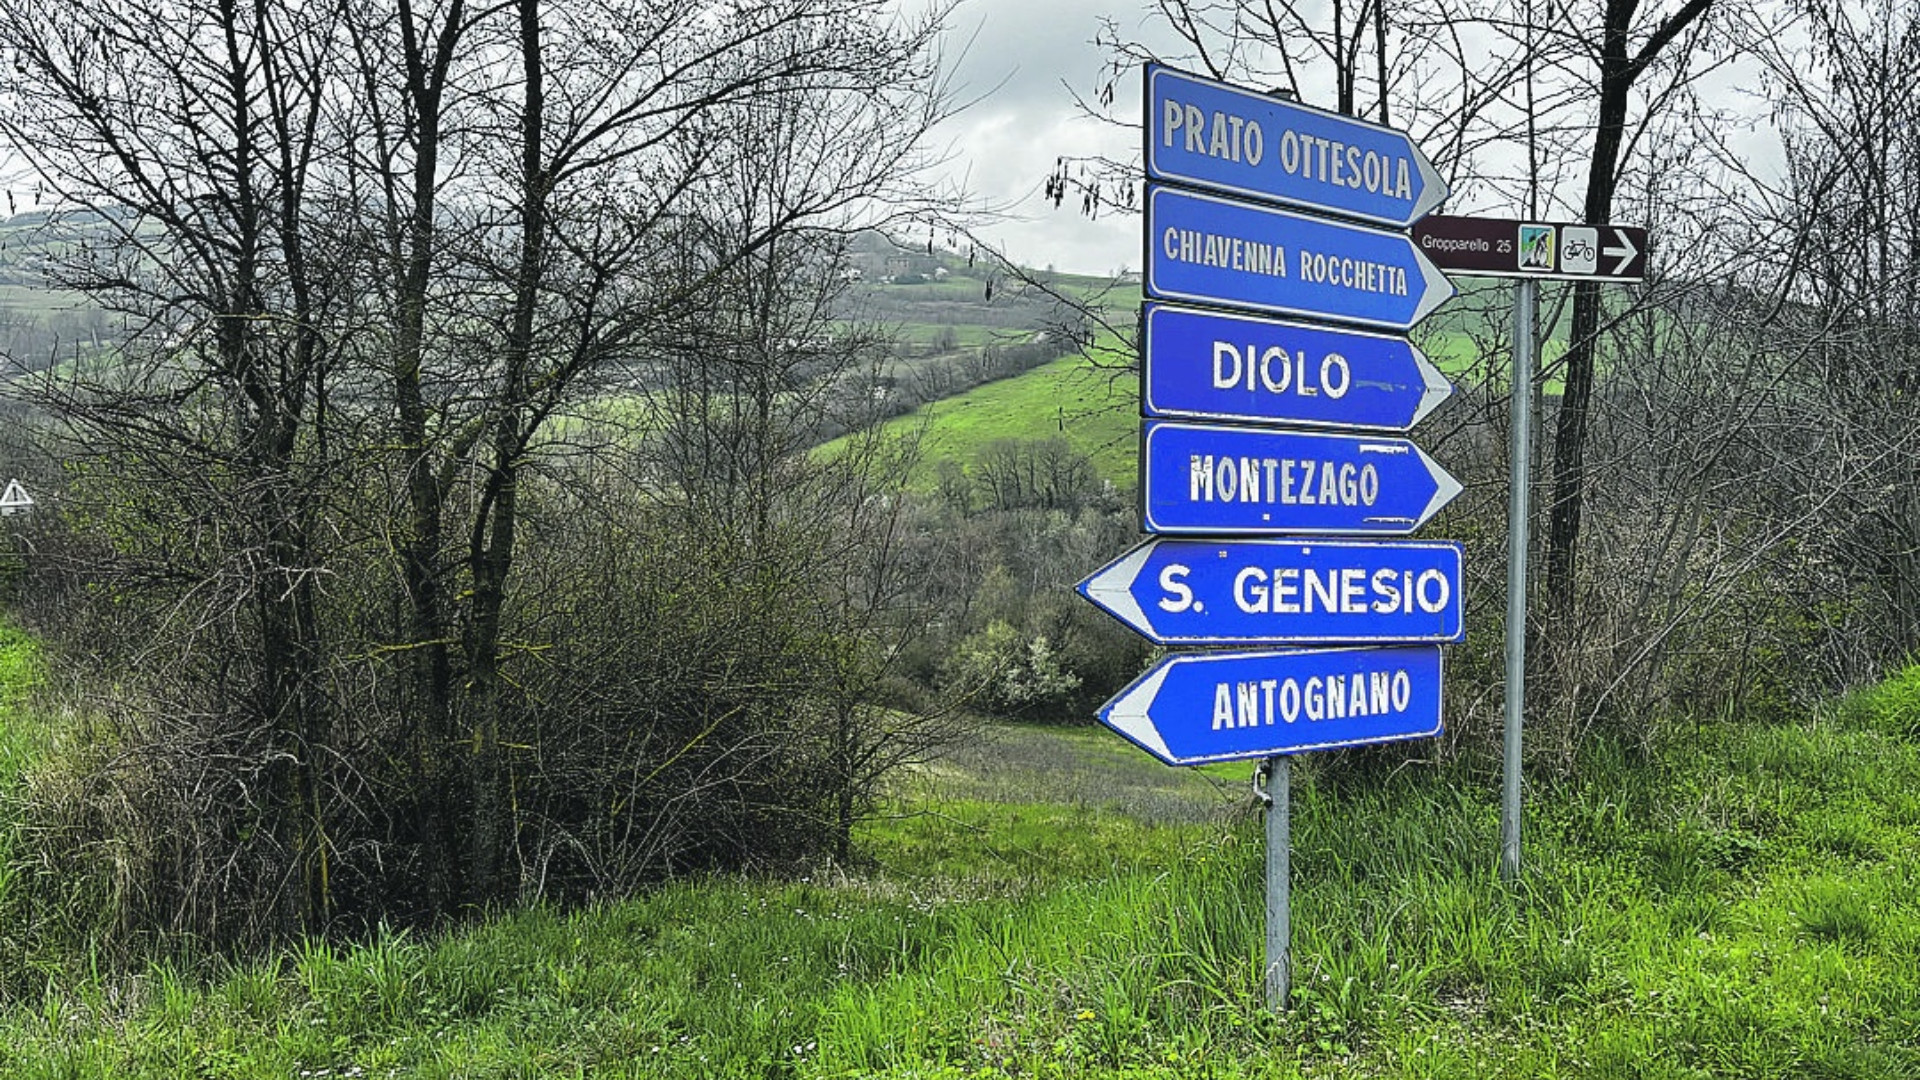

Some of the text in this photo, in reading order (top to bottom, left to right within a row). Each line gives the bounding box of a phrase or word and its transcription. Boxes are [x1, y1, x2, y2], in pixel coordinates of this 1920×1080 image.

[1162, 98, 1413, 202] PRATO OTTESOLA
[1163, 226, 1408, 297] CHIAVENNA ROCCHETTA
[1421, 233, 1512, 254] Gropparello 25
[1212, 340, 1351, 400] DIOLO
[1189, 454, 1380, 507] MONTEZAGO
[1157, 563, 1450, 615] S. GENESIO
[1211, 669, 1411, 731] ANTOGNANO
